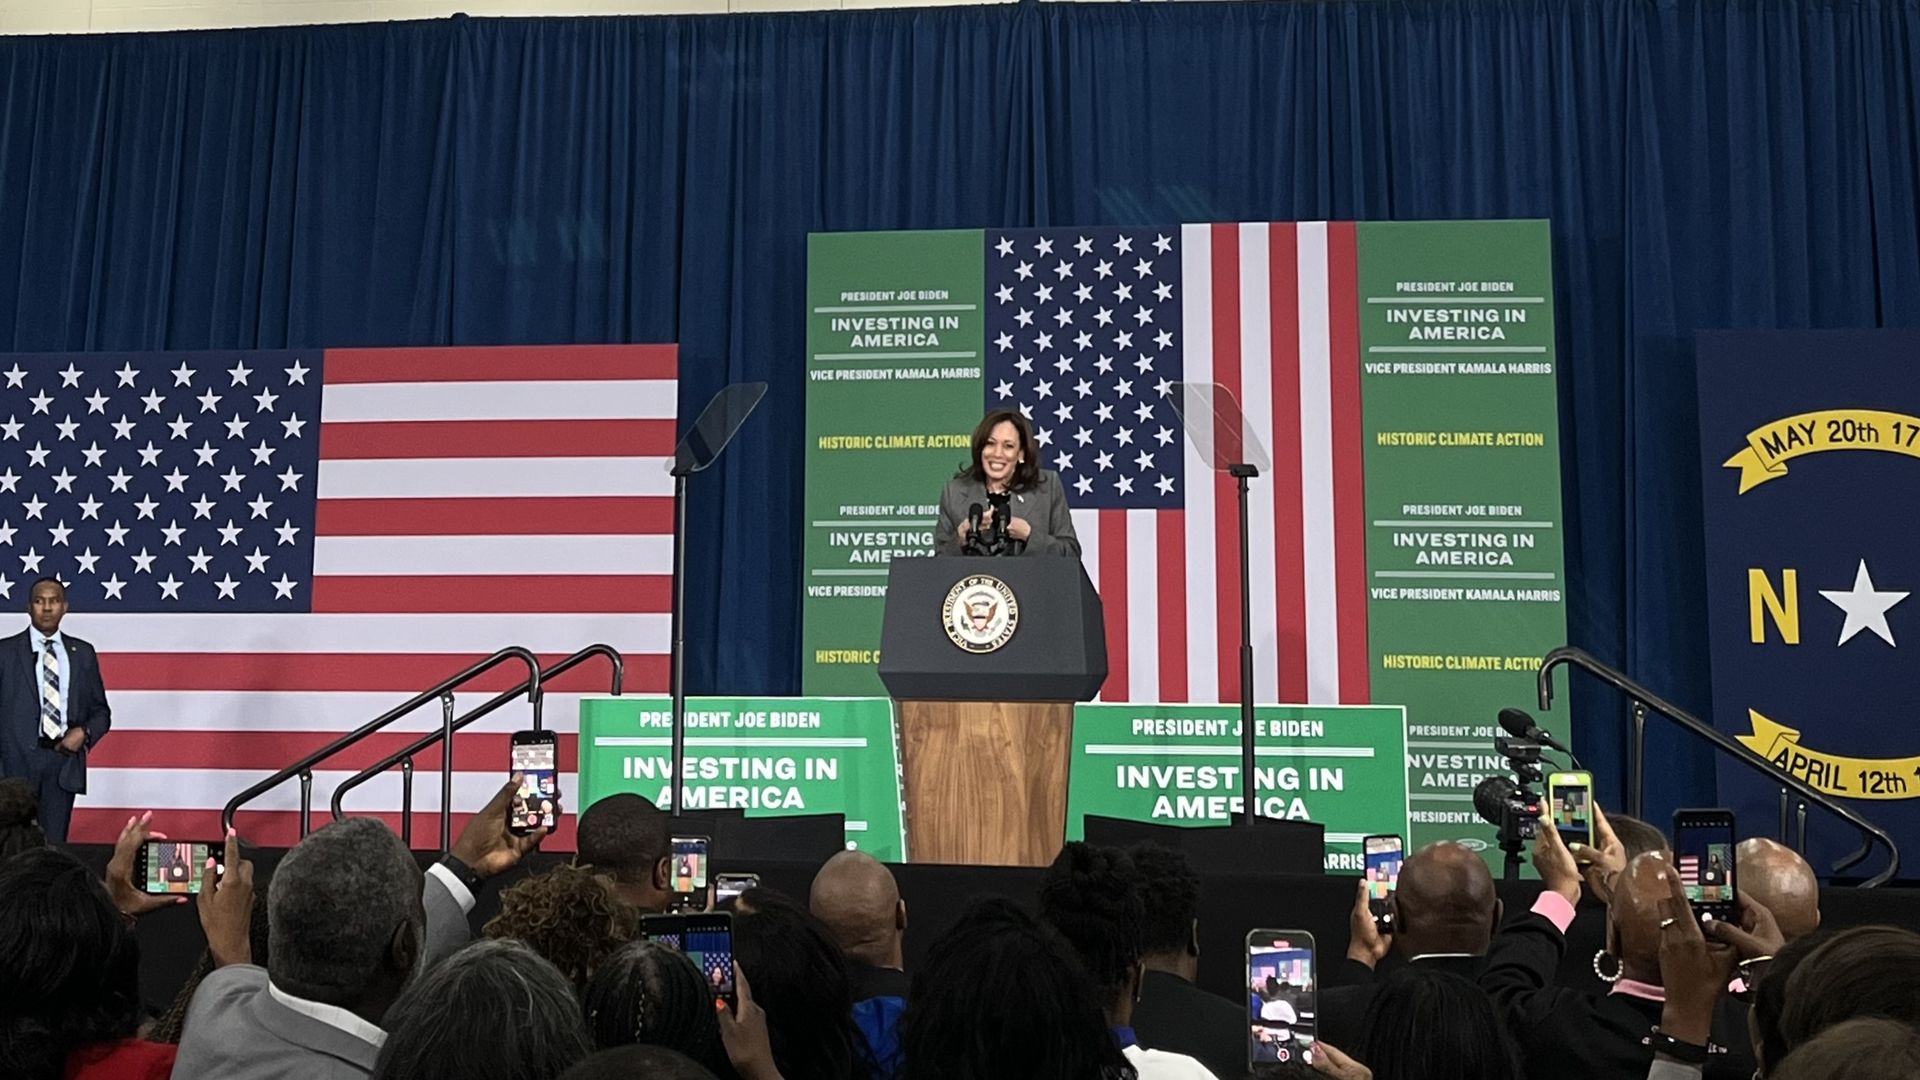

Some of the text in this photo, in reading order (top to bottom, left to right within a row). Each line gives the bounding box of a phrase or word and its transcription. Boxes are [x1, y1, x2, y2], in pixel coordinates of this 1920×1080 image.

[1396, 282, 1514, 292] PRESIDENT JOE BIDEN
[841, 290, 948, 302] PRESIDENT JOE BIDEN
[1386, 309, 1526, 323] INVESTING IN
[832, 316, 959, 332] INVESTING IN
[850, 333, 939, 348] AMERICA
[1408, 326, 1506, 340] AMERICA
[810, 368, 981, 381] VICE PRESIDENT KAMALA HARRIS
[1365, 362, 1552, 374] VICE PRESIDENT KAMALA HARRIS
[818, 434, 972, 450] HISTORIC CLIMATE ACTION
[1377, 432, 1544, 446] HISTORIC CLIMATE ACTION
[1759, 420, 1816, 460] MAY
[1827, 419, 1880, 443] 20th
[840, 505, 940, 516] PRESIDENT JOE BIDE
[1402, 504, 1522, 516] PRESIDENT JOE BIDEN
[830, 532, 934, 546] INVESTING
[1394, 532, 1534, 548] INVESTING IN
[1416, 550, 1514, 566] AMERICA
[808, 586, 832, 597] VICE
[1371, 588, 1560, 602] VICE PRESIDENT KAMALA HARRIS
[1748, 568, 1800, 644] N
[816, 650, 871, 664] HISTORIC
[1383, 654, 1544, 670] HISTORIC CLIMATE ACTIO
[640, 712, 820, 728] PREIDENT JOE BIDEN
[1132, 718, 1324, 737] PRESIDENT JE BIDEN
[1409, 726, 1470, 737] PRESIDENT
[1472, 726, 1493, 737] JOE
[624, 756, 838, 780] INVESTING IN
[1408, 754, 1510, 770] NVESTING
[1772, 747, 1906, 794] APRIL 12th
[1116, 766, 1344, 791] INVESTNG IN
[656, 786, 805, 809] AMERICA
[1324, 853, 1364, 870] RRIS
